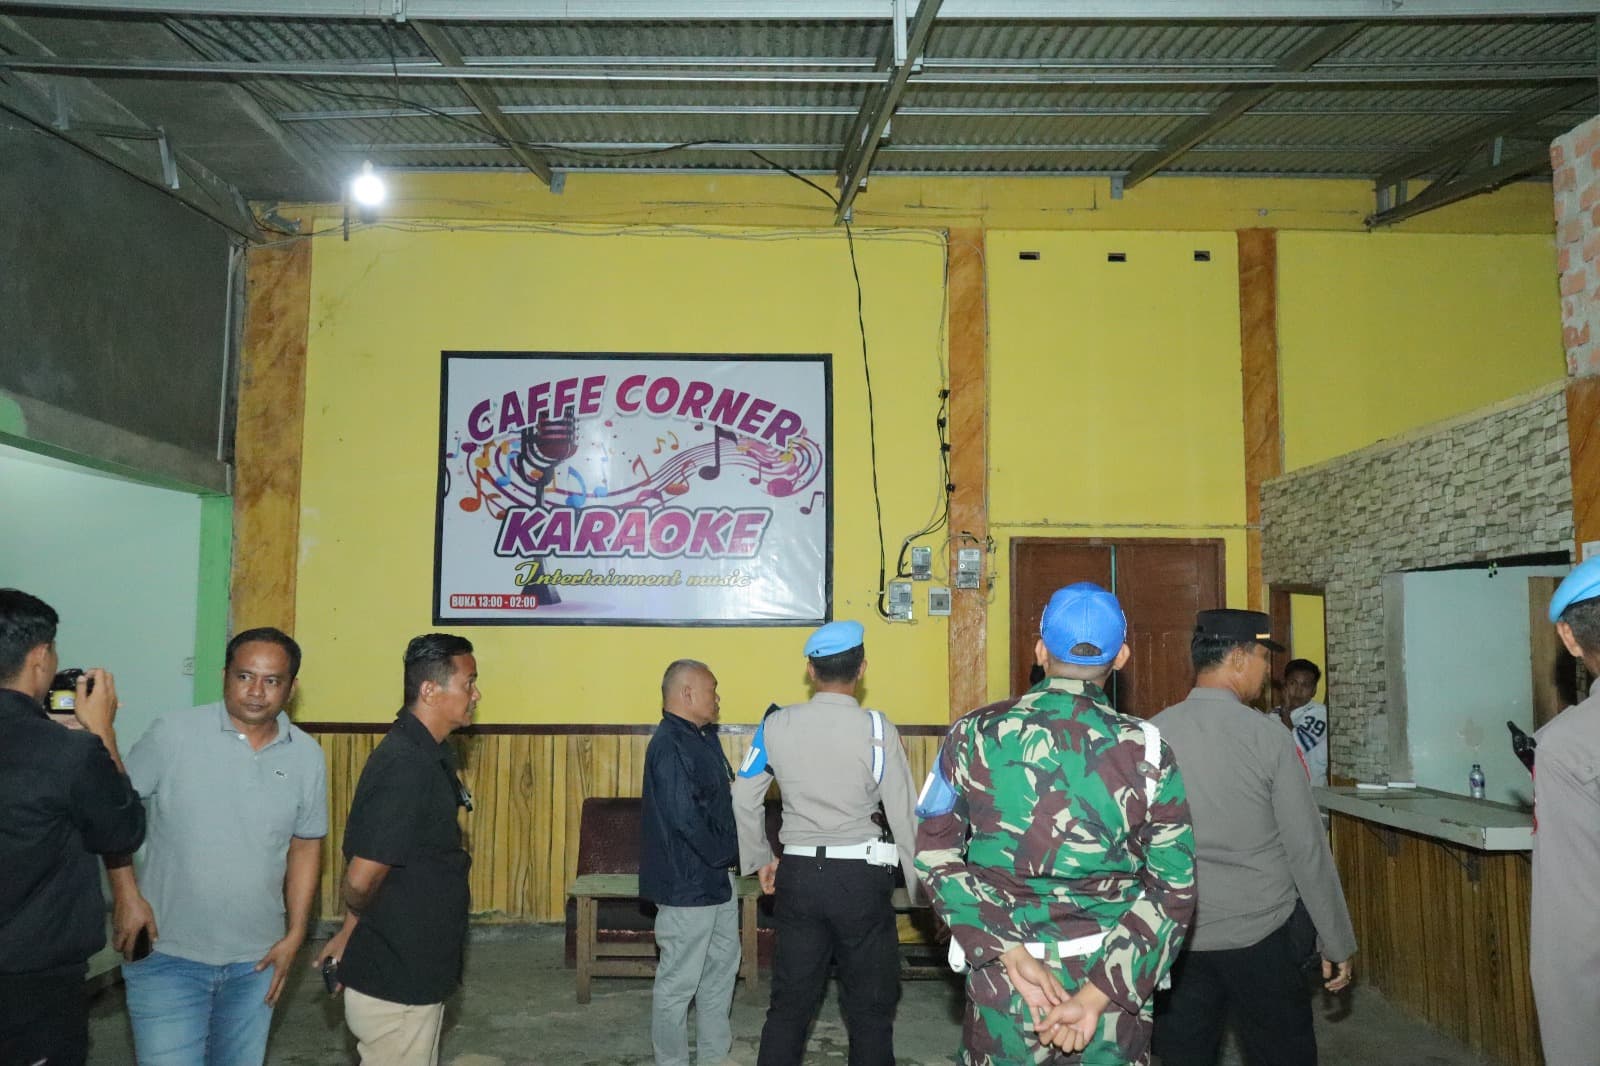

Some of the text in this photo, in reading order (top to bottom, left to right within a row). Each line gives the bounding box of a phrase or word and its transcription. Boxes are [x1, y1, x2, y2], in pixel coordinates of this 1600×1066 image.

[467, 374, 804, 447] CAFFE CORNER
[498, 508, 770, 556] KARAOKE
[686, 568, 751, 587] music
[451, 595, 477, 608] BUKA
[479, 595, 502, 608] 13:00
[509, 596, 536, 608] 02:00
[1300, 715, 1326, 737] 39
